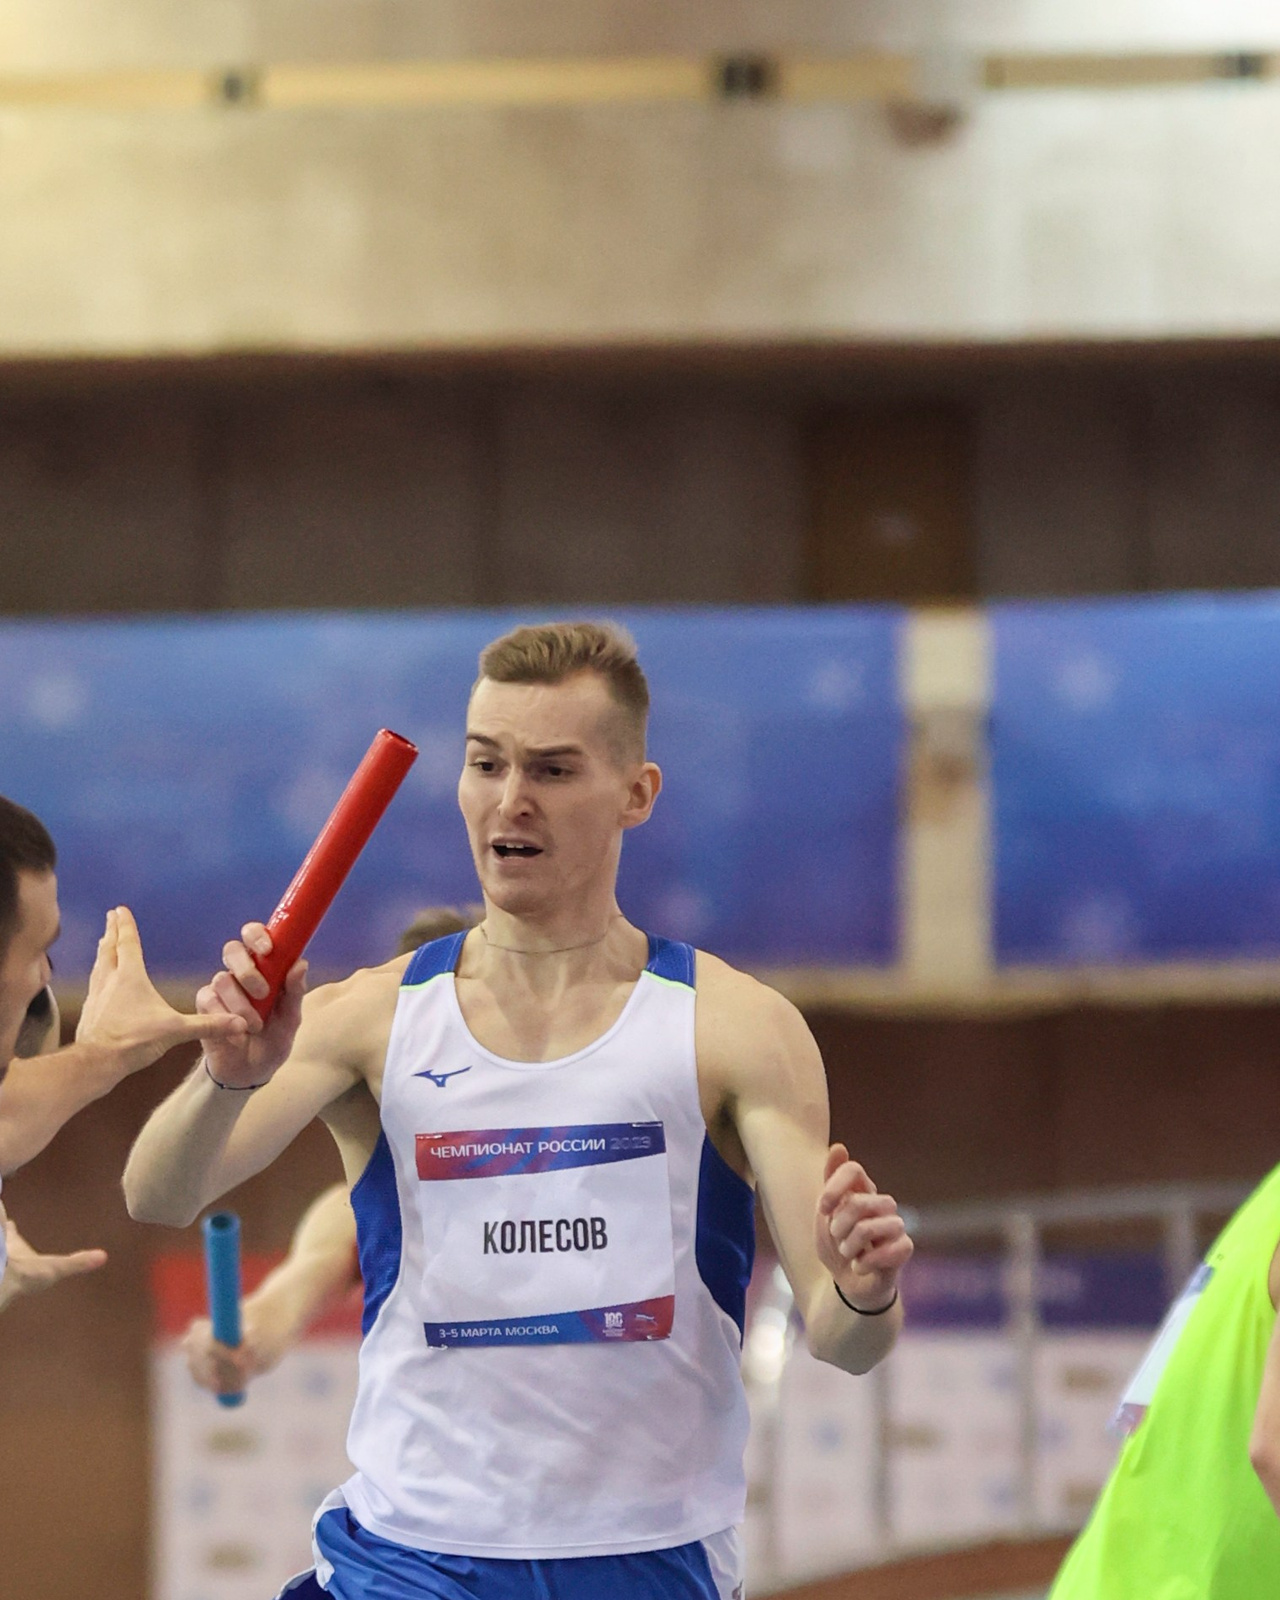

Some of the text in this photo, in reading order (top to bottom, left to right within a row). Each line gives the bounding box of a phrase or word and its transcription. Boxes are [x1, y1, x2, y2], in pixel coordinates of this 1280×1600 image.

[430, 1141, 534, 1159] ЧЕМПИОНАТ
[538, 1138, 606, 1154] РОССИИ
[483, 1217, 608, 1255] КОЛЕСОВ
[461, 1326, 502, 1338] МАРТА
[504, 1324, 559, 1337] МОСКВА
